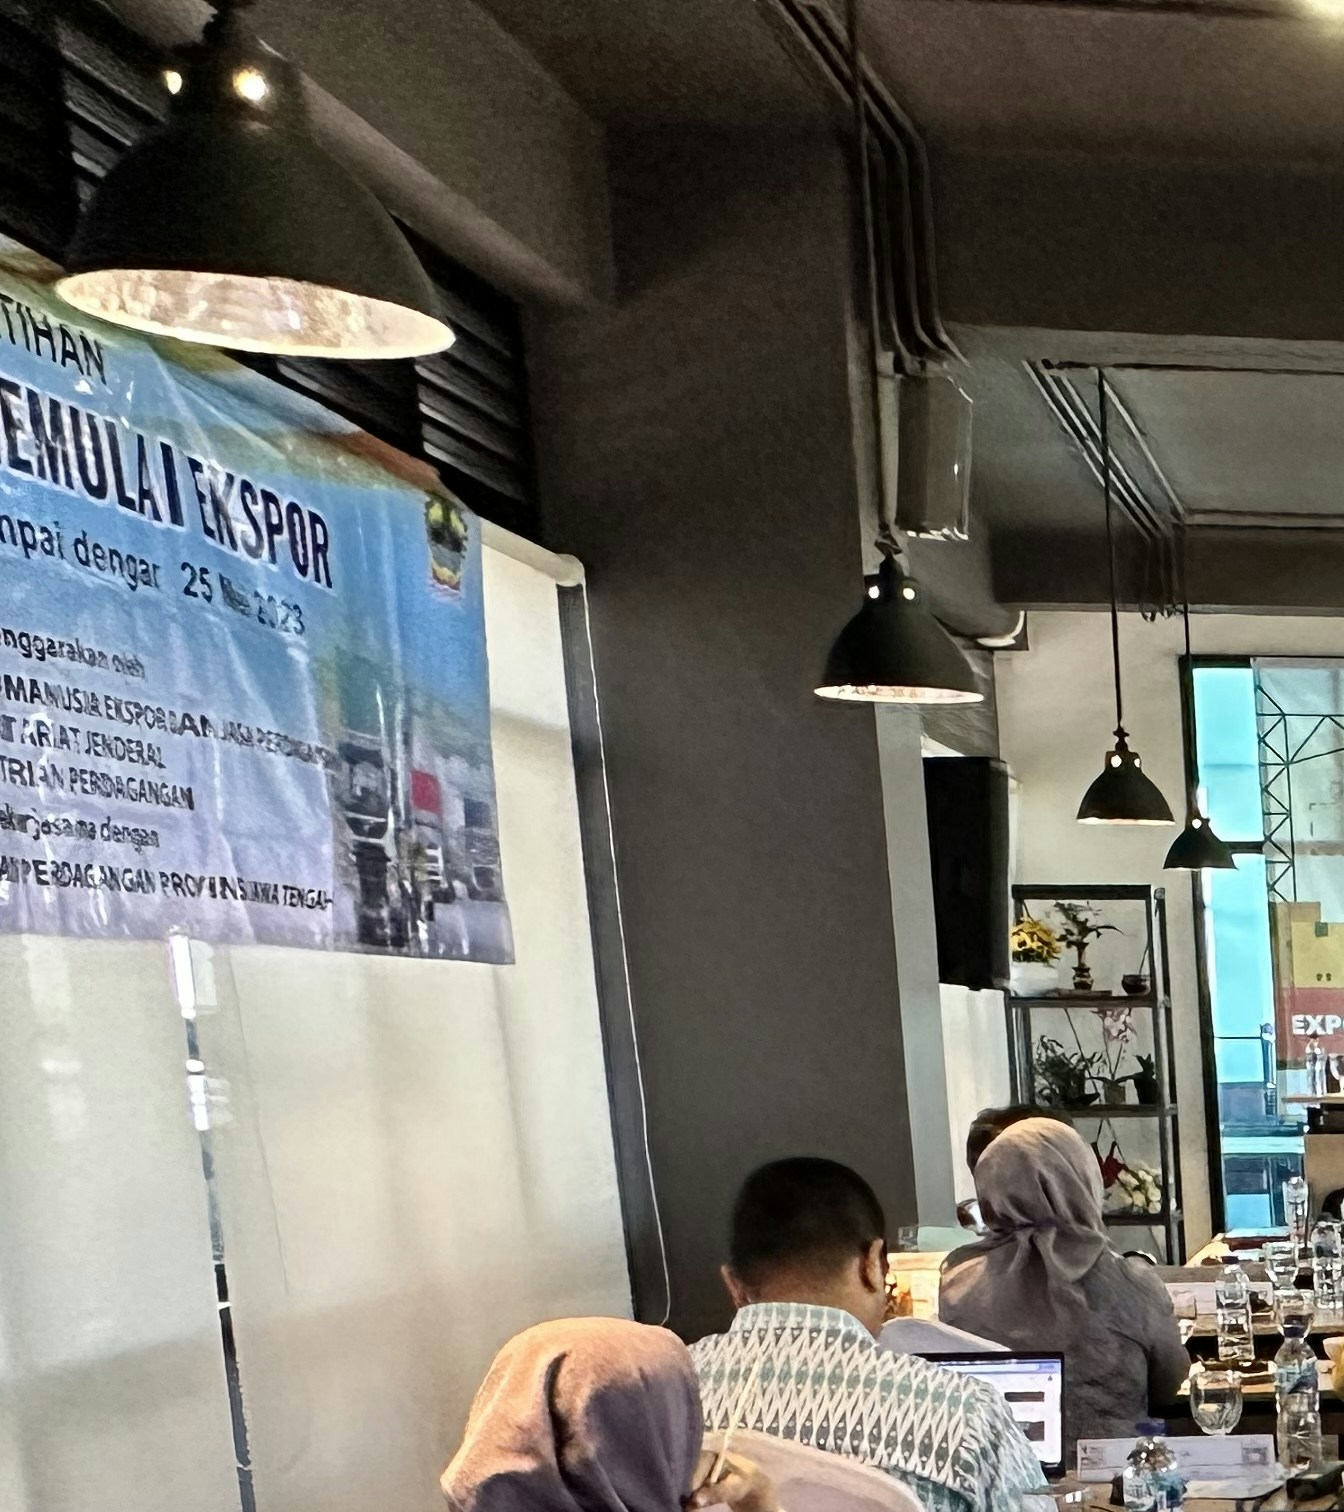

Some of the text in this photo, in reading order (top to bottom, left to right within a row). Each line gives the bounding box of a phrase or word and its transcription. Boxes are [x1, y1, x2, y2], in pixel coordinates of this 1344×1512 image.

[0, 293, 107, 386] TIHAN
[0, 377, 334, 590] EMULAI EKSPOR
[181, 561, 213, 603] 25
[0, 627, 110, 670] nggarakan
[159, 870, 250, 901] PROVINS
